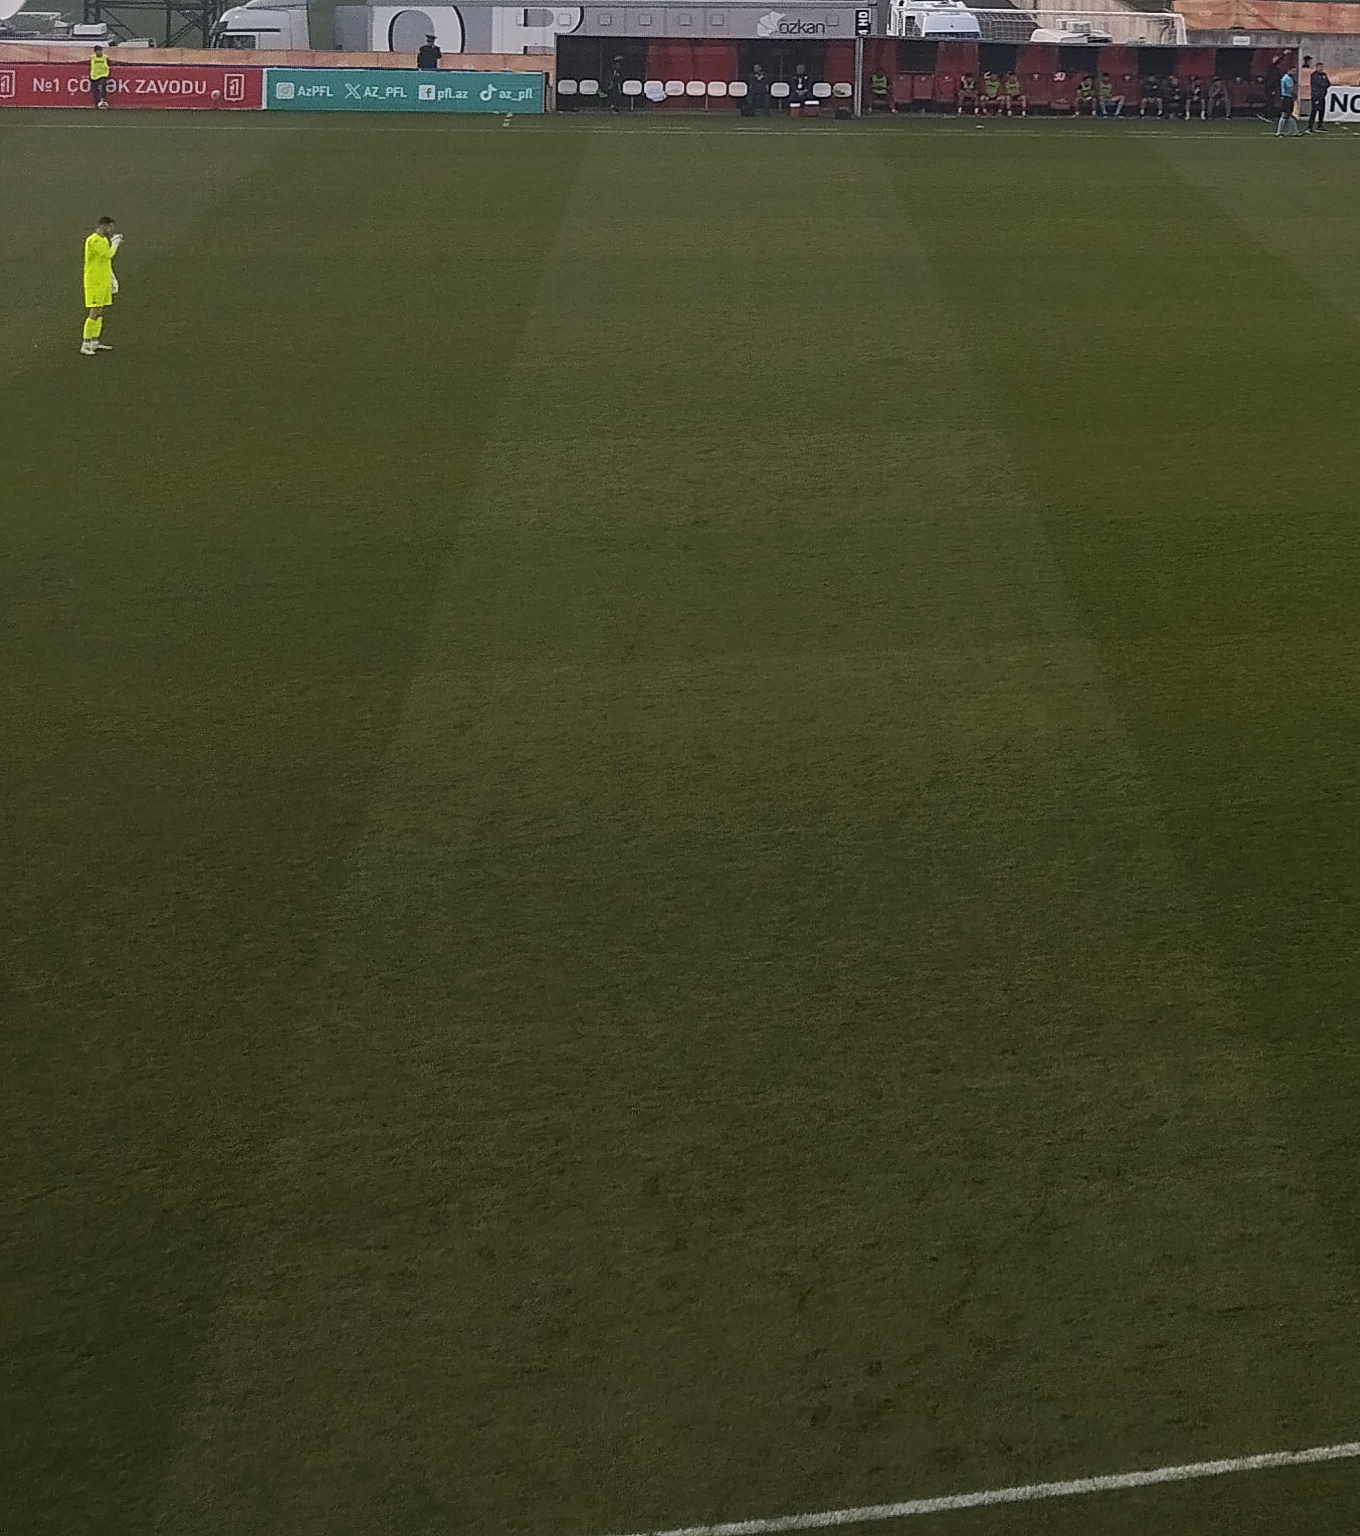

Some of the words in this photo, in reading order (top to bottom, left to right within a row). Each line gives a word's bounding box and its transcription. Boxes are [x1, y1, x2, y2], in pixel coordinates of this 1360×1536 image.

[67, 75, 129, 96] ÇÖƏK
[136, 79, 207, 95] ZAVODU
[297, 84, 334, 97] AzPFL
